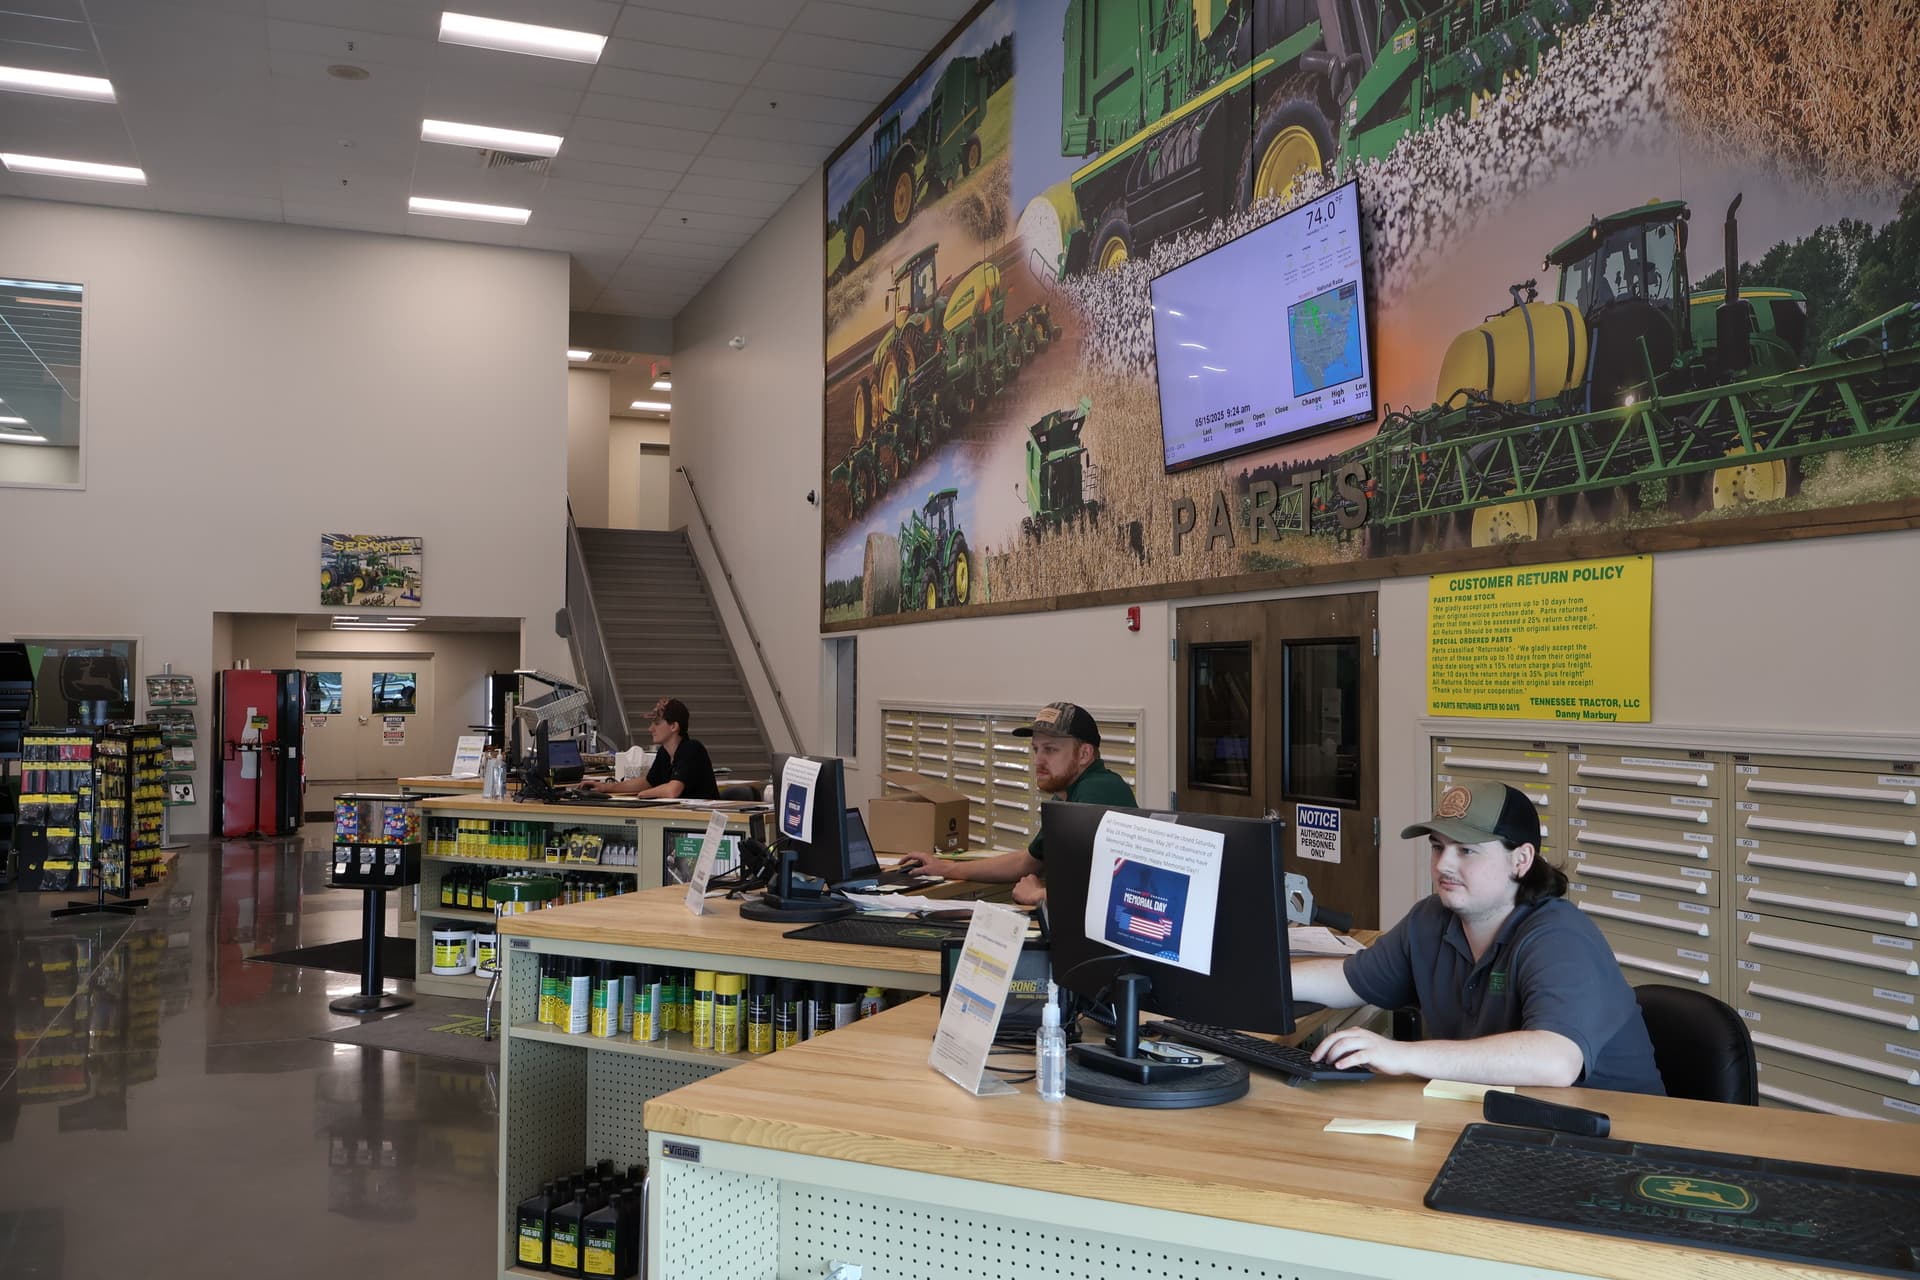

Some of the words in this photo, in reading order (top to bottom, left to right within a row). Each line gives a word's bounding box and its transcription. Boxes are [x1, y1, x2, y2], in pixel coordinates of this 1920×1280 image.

[1203, 428, 1212, 436] Last
[1224, 419, 1244, 429] Previous
[1253, 412, 1265, 421] Open
[1275, 406, 1288, 414] Close
[1302, 395, 1321, 406] Change
[1331, 388, 1344, 398] High
[1227, 406, 1239, 418] 9:24
[1240, 404, 1251, 414] am
[1171, 460, 1369, 556] PARTS
[333, 541, 412, 553] SERVICE
[1450, 575, 1513, 591] CUSTOMER
[1517, 570, 1568, 586] RETURN
[1573, 565, 1624, 582] POLICY
[1551, 598, 1566, 606] days
[1526, 625, 1551, 633] original
[1572, 623, 1598, 631] receipt.
[1566, 652, 1592, 660] original
[1568, 661, 1592, 669] freight.
[1457, 702, 1481, 710] RETURNED
[1530, 698, 1576, 706] TENNESSEE
[1579, 699, 1621, 708] TRACTOR,
[1623, 699, 1640, 707] LLC
[1556, 710, 1580, 720] Danny
[1583, 710, 1617, 722] Marbury
[1300, 810, 1337, 828] NOTICE
[1301, 829, 1336, 841] AUTHORIZED
[1301, 838, 1336, 850] PERSONNEL
[1311, 848, 1325, 858] ONLY
[1124, 892, 1153, 909] MEMORIAL
[1154, 901, 1168, 912] DAY
[1743, 913, 1754, 921] 905
[669, 1145, 700, 1159] Vidmar
